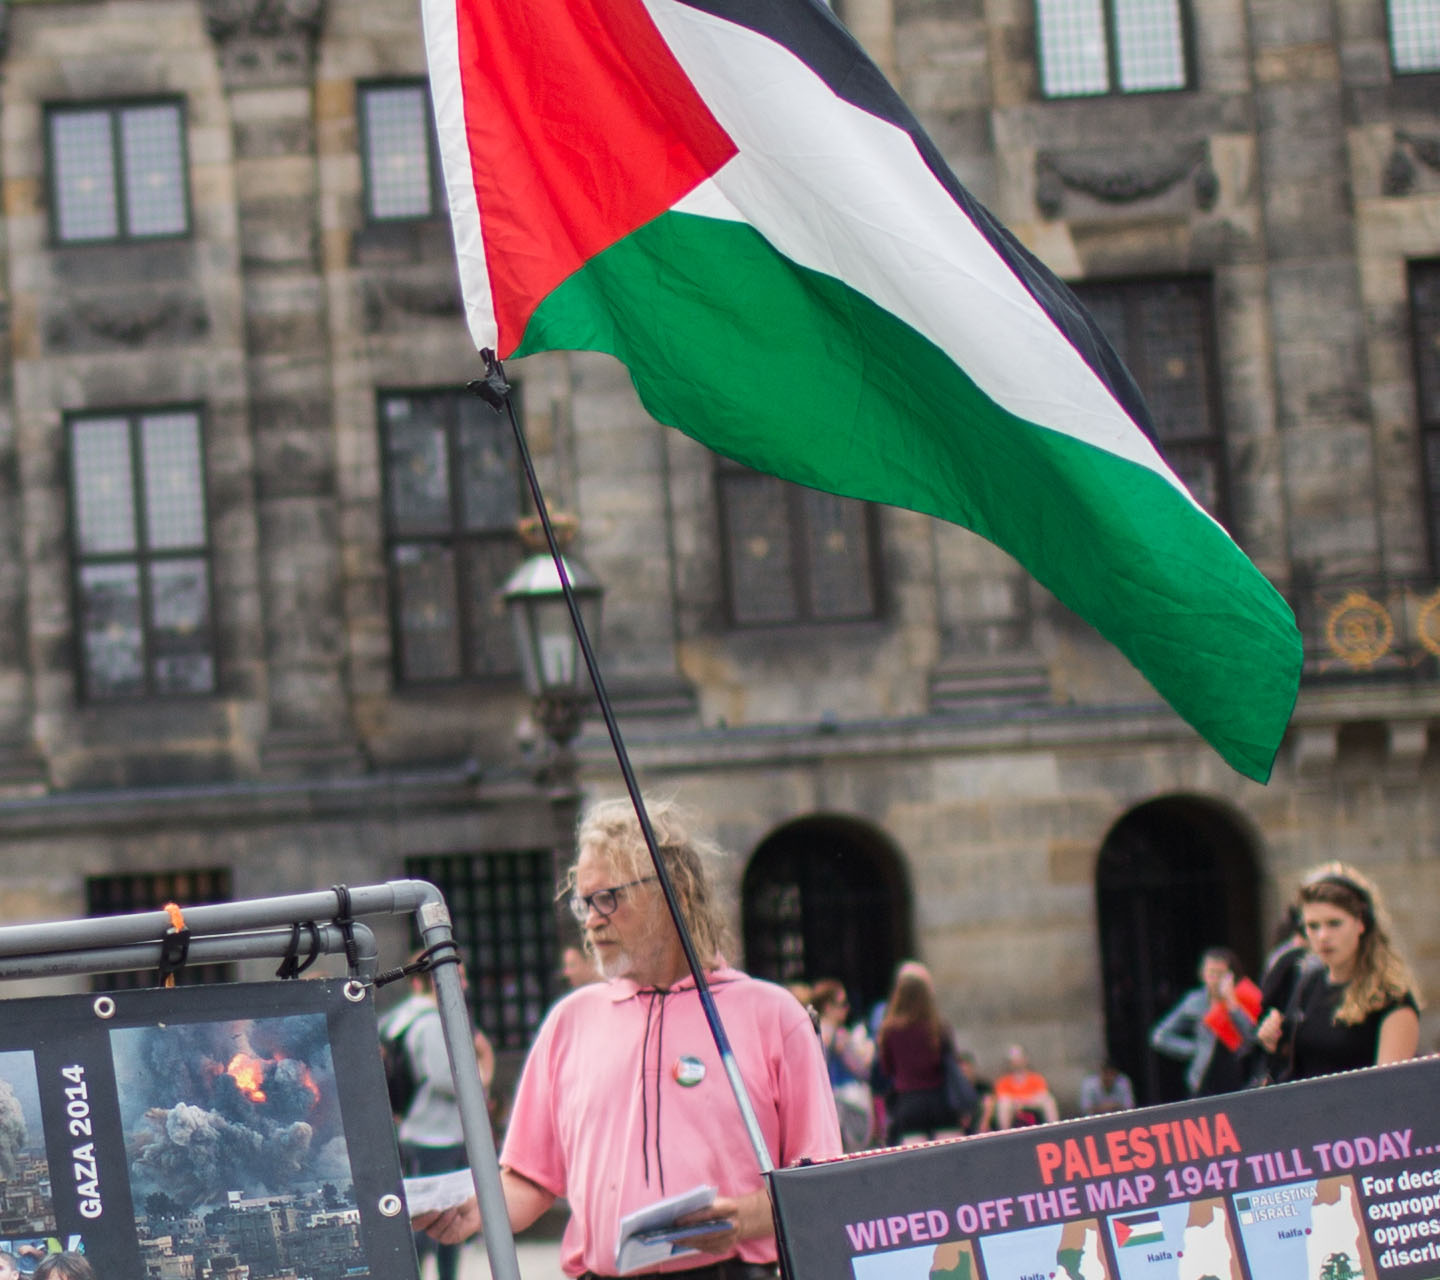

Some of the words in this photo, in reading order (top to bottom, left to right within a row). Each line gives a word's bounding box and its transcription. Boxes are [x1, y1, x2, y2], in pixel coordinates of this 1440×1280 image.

[62, 1065, 92, 1136] 2014
[1036, 1112, 1241, 1184] PALESTINA
[73, 1143, 102, 1218] GAZA
[1361, 1176, 1394, 1196] For
[846, 1206, 955, 1251] WIPED
[958, 1196, 1015, 1236] OFF
[1018, 1184, 1081, 1226] THE
[1086, 1172, 1157, 1214] MAP
[1166, 1160, 1240, 1201] 1947
[1246, 1148, 1312, 1187] TILL
[1251, 1186, 1318, 1208] PALESTINA
[1254, 1204, 1299, 1222] ISRAEL
[1278, 1229, 1303, 1240] Haifa
[1147, 1252, 1172, 1263] Haifa
